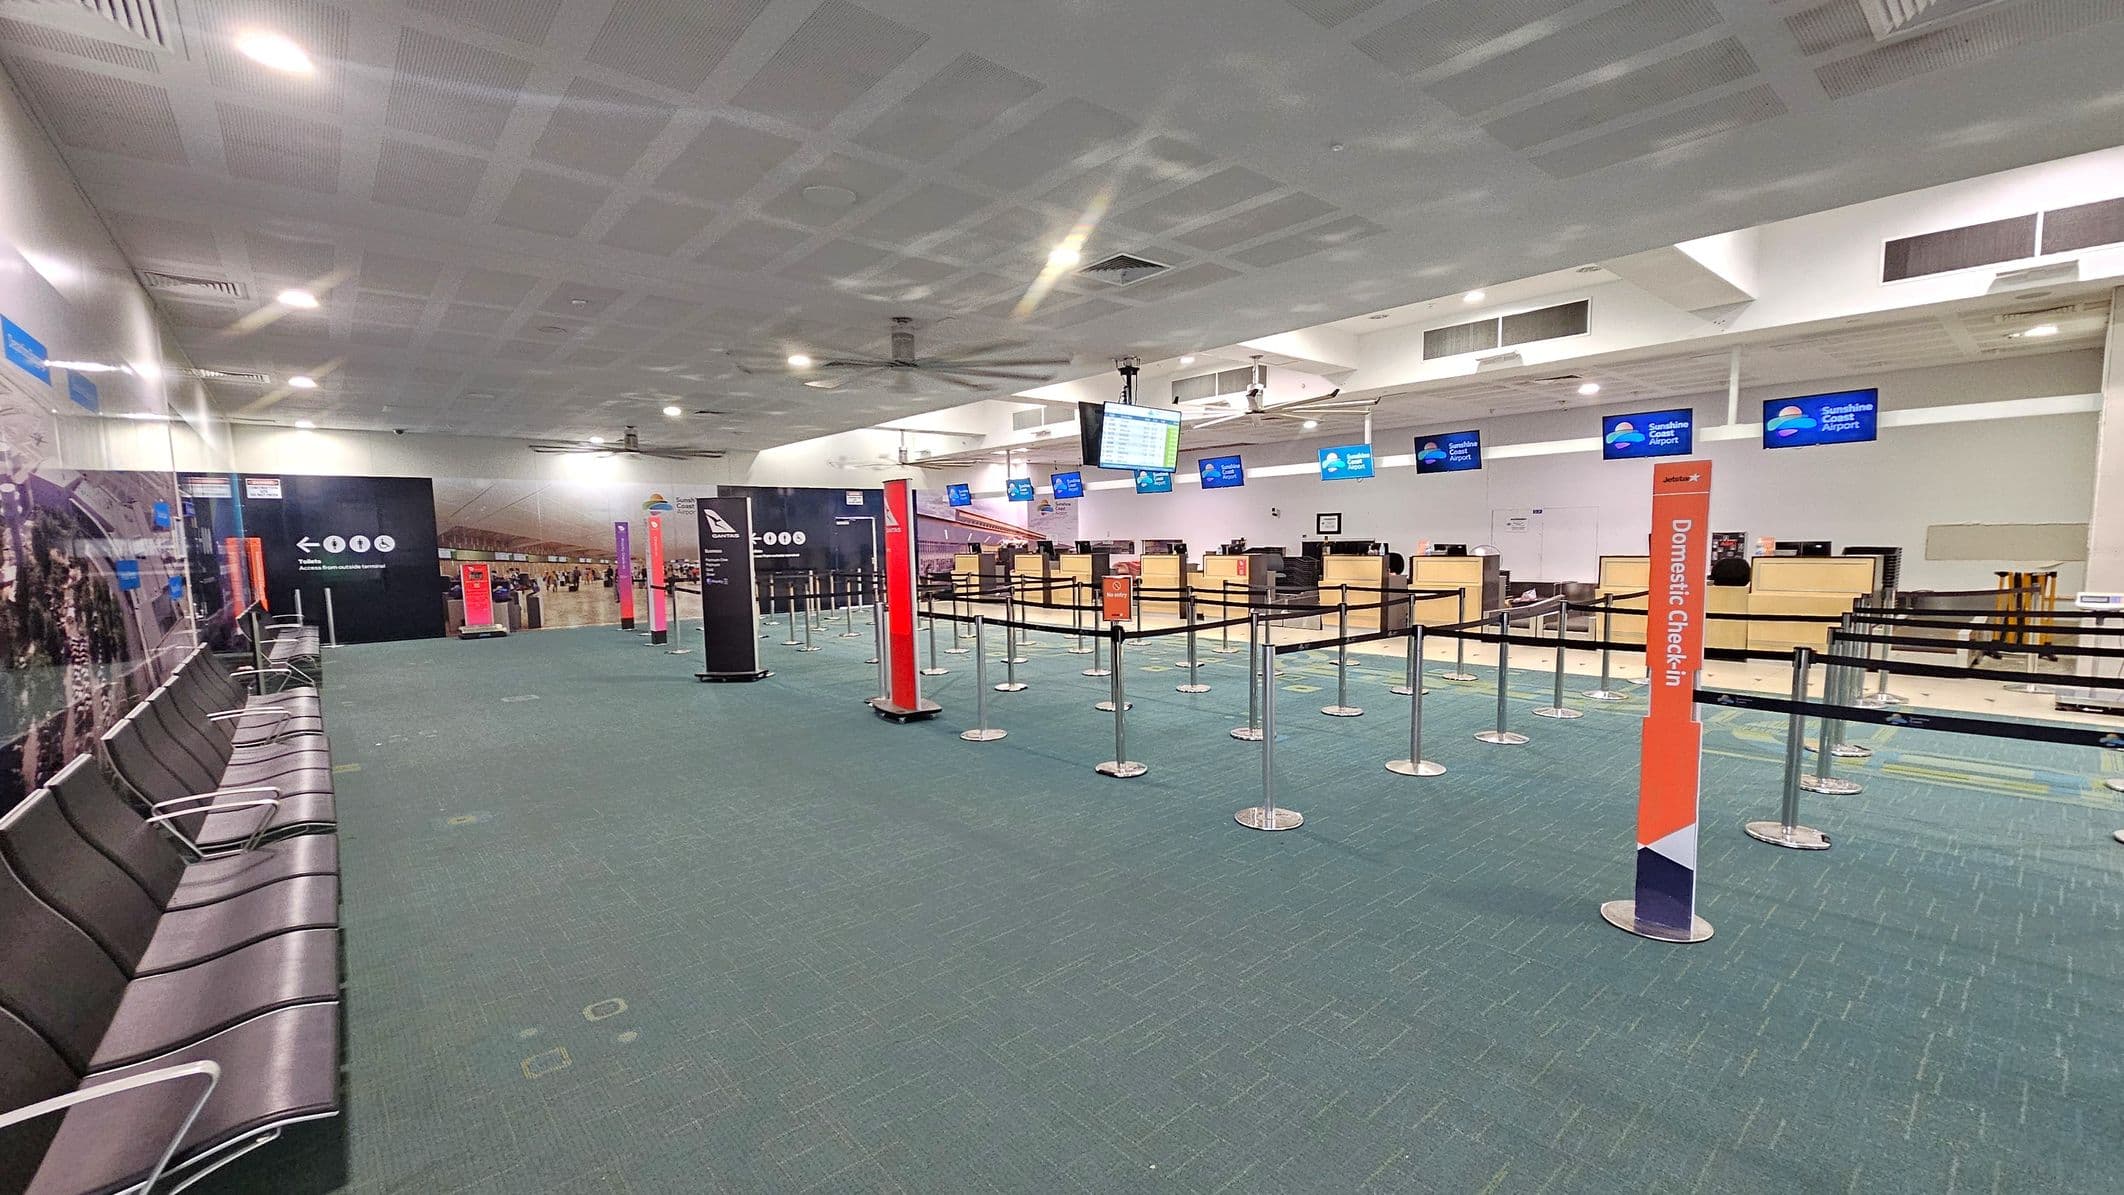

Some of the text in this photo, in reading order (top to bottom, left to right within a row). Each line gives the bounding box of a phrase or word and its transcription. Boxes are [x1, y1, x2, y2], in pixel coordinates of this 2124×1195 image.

[1820, 402, 1874, 415] Sunshine
[1821, 412, 1855, 423] Coast
[1649, 420, 1689, 431] Sunshine
[1821, 420, 1860, 432] Airport
[1649, 429, 1675, 438] Coast
[1448, 441, 1478, 449] Sunshine
[1649, 436, 1679, 446] Airport
[1450, 454, 1472, 462] Airport
[1114, 591, 1128, 599] entry
[1665, 519, 1692, 687] Domestic Check-in
